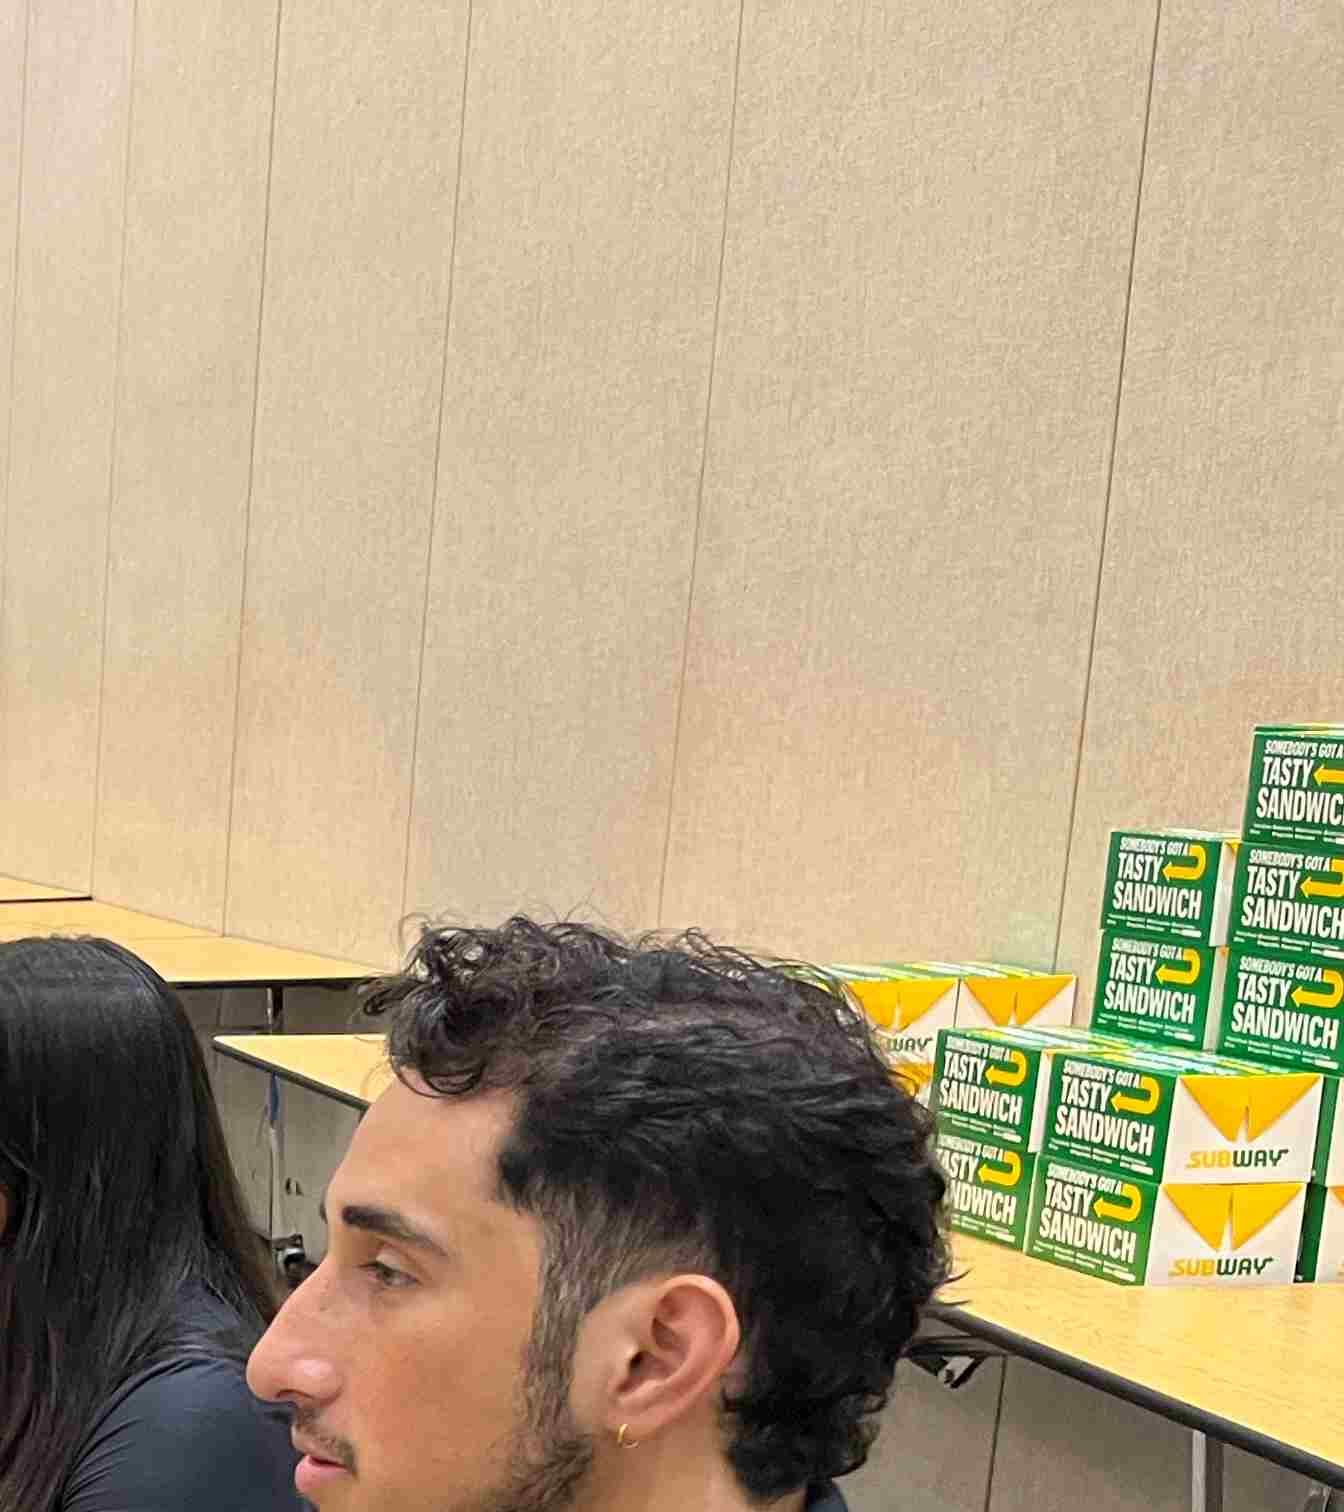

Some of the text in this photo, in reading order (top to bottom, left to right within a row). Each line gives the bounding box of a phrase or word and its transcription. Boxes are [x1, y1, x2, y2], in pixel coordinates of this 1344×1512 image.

[1262, 756, 1314, 788] TASTY
[1256, 787, 1344, 826] SANDWIC
[1118, 852, 1163, 884] TASTY
[1247, 865, 1300, 899] TASTY
[1112, 881, 1202, 920] SANDWICH
[1241, 895, 1344, 940] SANDWICH
[1109, 952, 1156, 985] TASTY
[1104, 980, 1196, 1024] SANDWICH
[1237, 972, 1292, 1008] TASTY
[1231, 1002, 1339, 1050] SANDWICH
[943, 1051, 986, 1085] TASTY
[939, 1077, 1023, 1125] SANDWICH
[1061, 1075, 1112, 1112] TASTY
[1055, 1105, 1156, 1157] SANDWICH
[1186, 1148, 1289, 1169] SUBWAY
[949, 1179, 1017, 1226] NDWICH
[1045, 1178, 1094, 1217] TASTY
[1039, 1207, 1136, 1264] SANDWICH
[1168, 1256, 1273, 1277] SUBWAY
